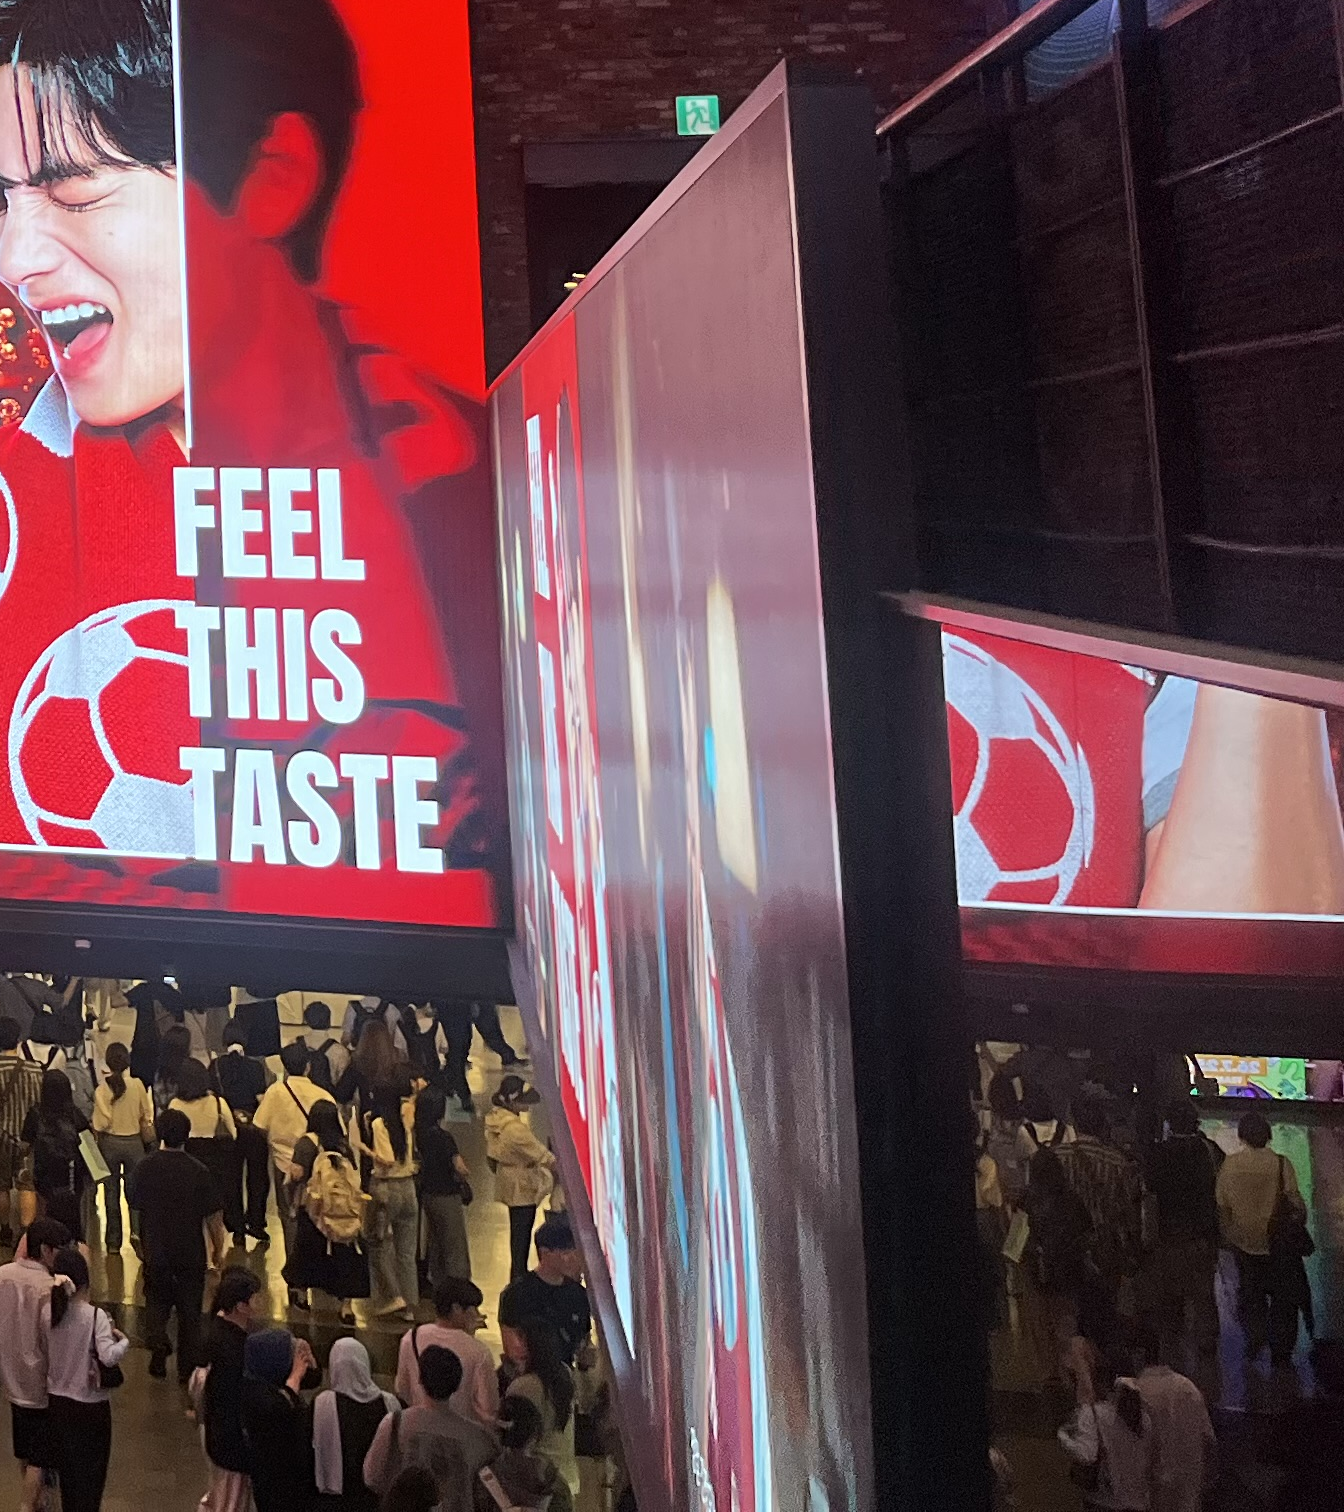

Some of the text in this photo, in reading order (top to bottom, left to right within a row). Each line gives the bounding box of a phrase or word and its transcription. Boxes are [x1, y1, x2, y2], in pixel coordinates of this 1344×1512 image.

[172, 466, 366, 580] FEEL
[174, 606, 365, 724] THIS
[178, 746, 444, 874] TASTE
